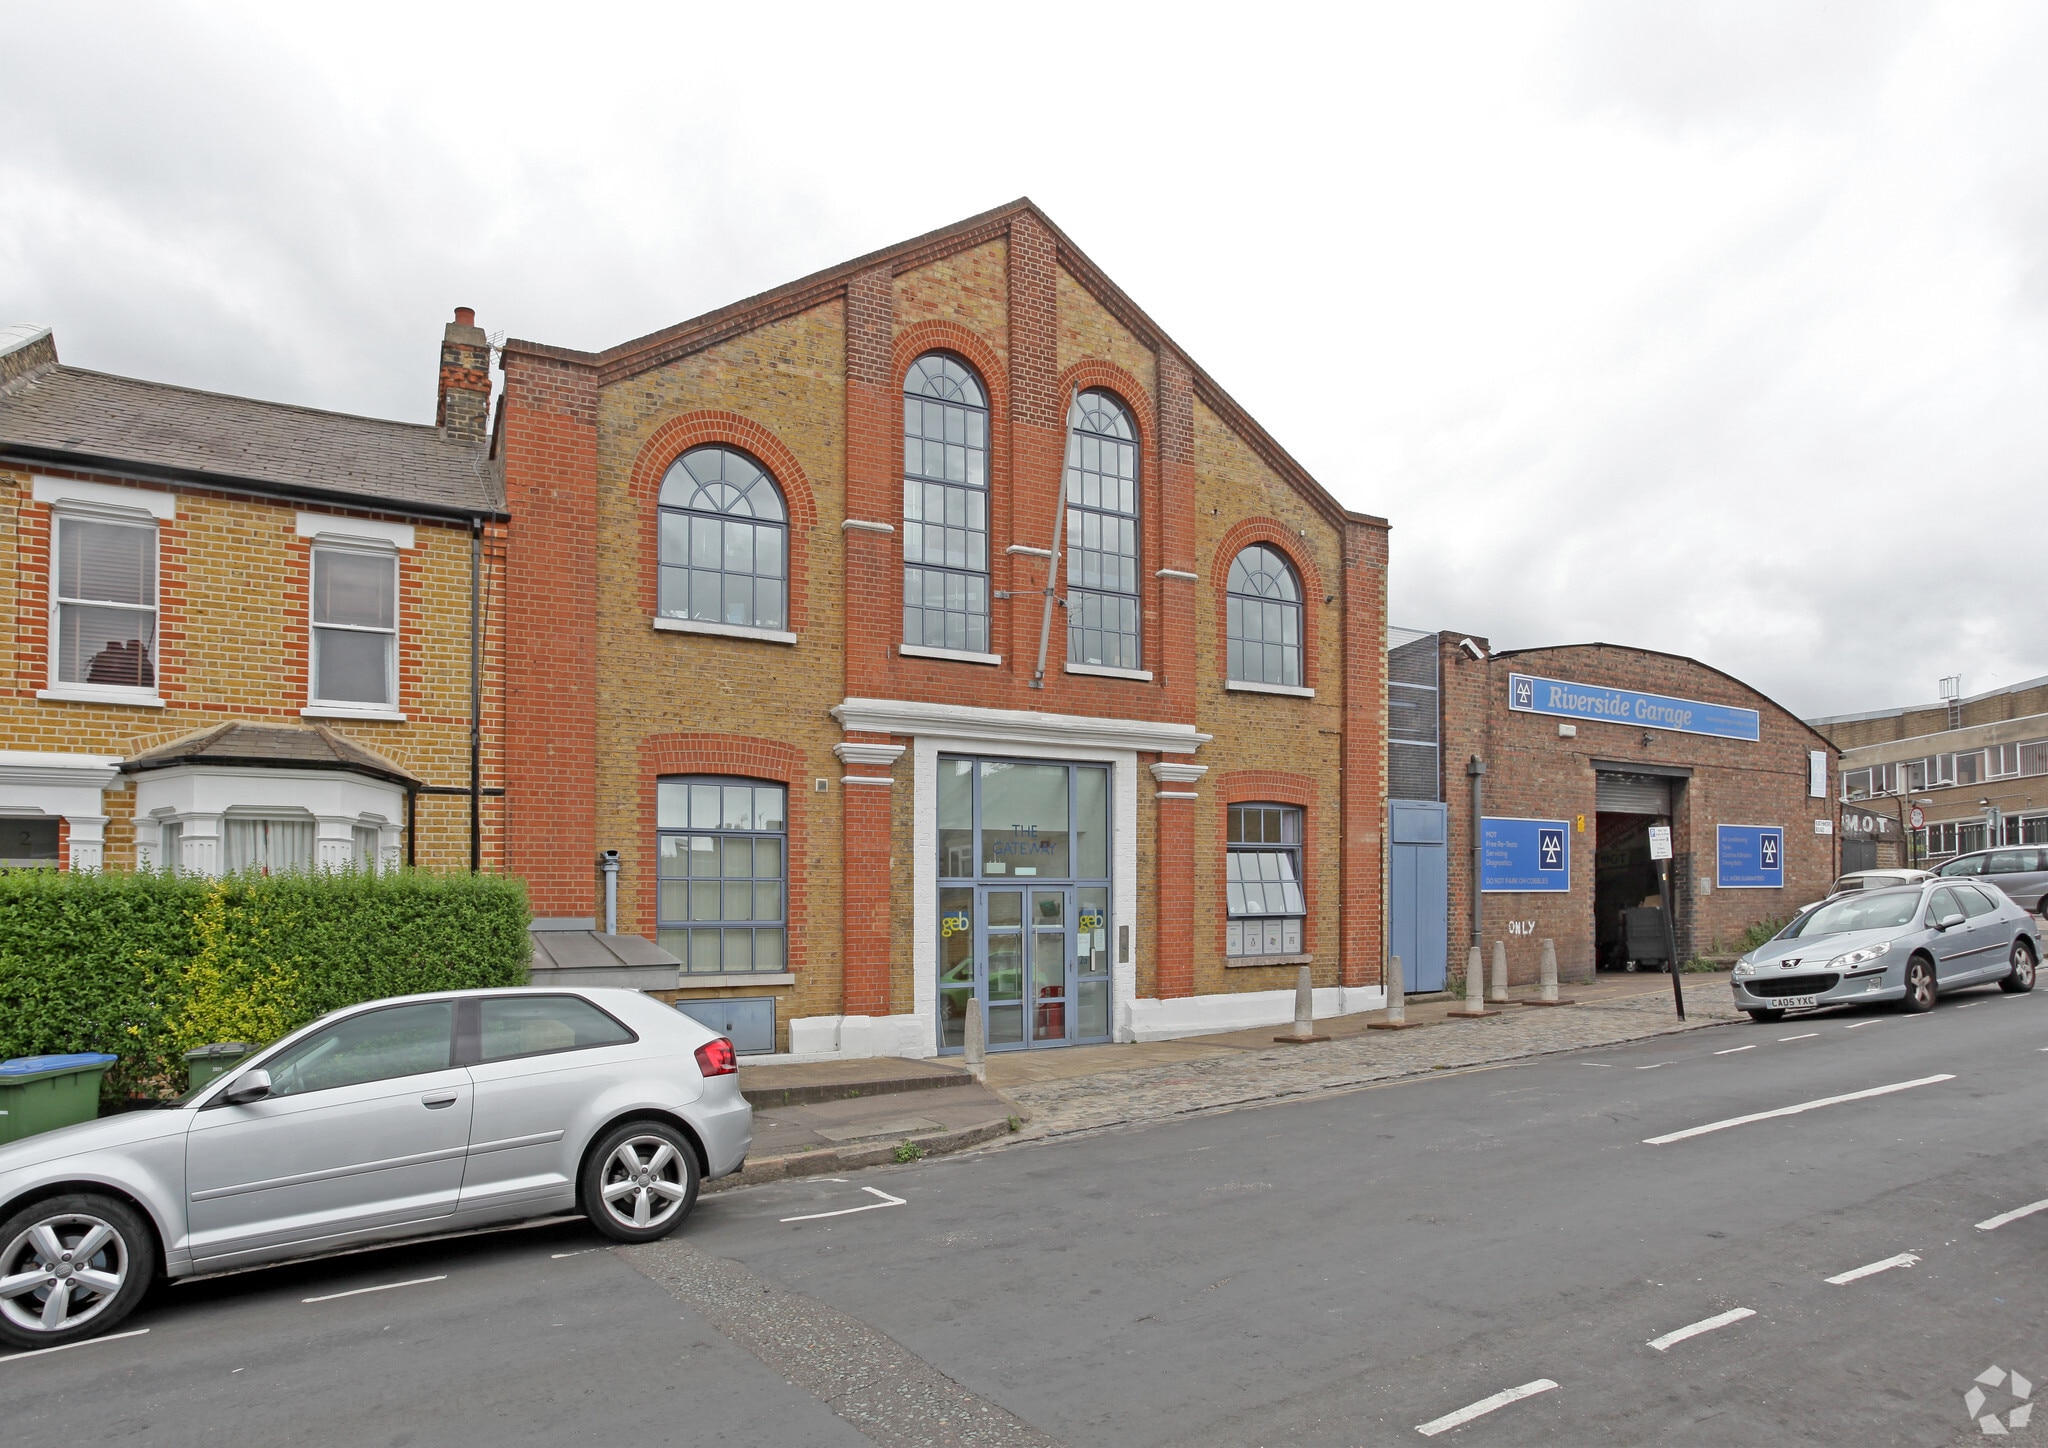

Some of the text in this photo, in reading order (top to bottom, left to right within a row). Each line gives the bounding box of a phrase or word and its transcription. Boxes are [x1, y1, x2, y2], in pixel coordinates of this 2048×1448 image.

[1548, 686, 1692, 729] Riverside Garage
[1012, 824, 1038, 838] THE
[20, 831, 31, 846] 2
[1497, 840, 1518, 848] Re-Tests
[993, 840, 1057, 856] GATEWAY
[1486, 850, 1508, 858] Servicing
[1486, 859, 1512, 867] Diagnostics
[1486, 877, 1549, 885] DO NOT PARK ON COBBLES
[941, 911, 969, 937] geb
[1079, 908, 1103, 934] geb
[1508, 920, 1536, 935] ONLY
[1771, 996, 1815, 1007] CA05 YXC
